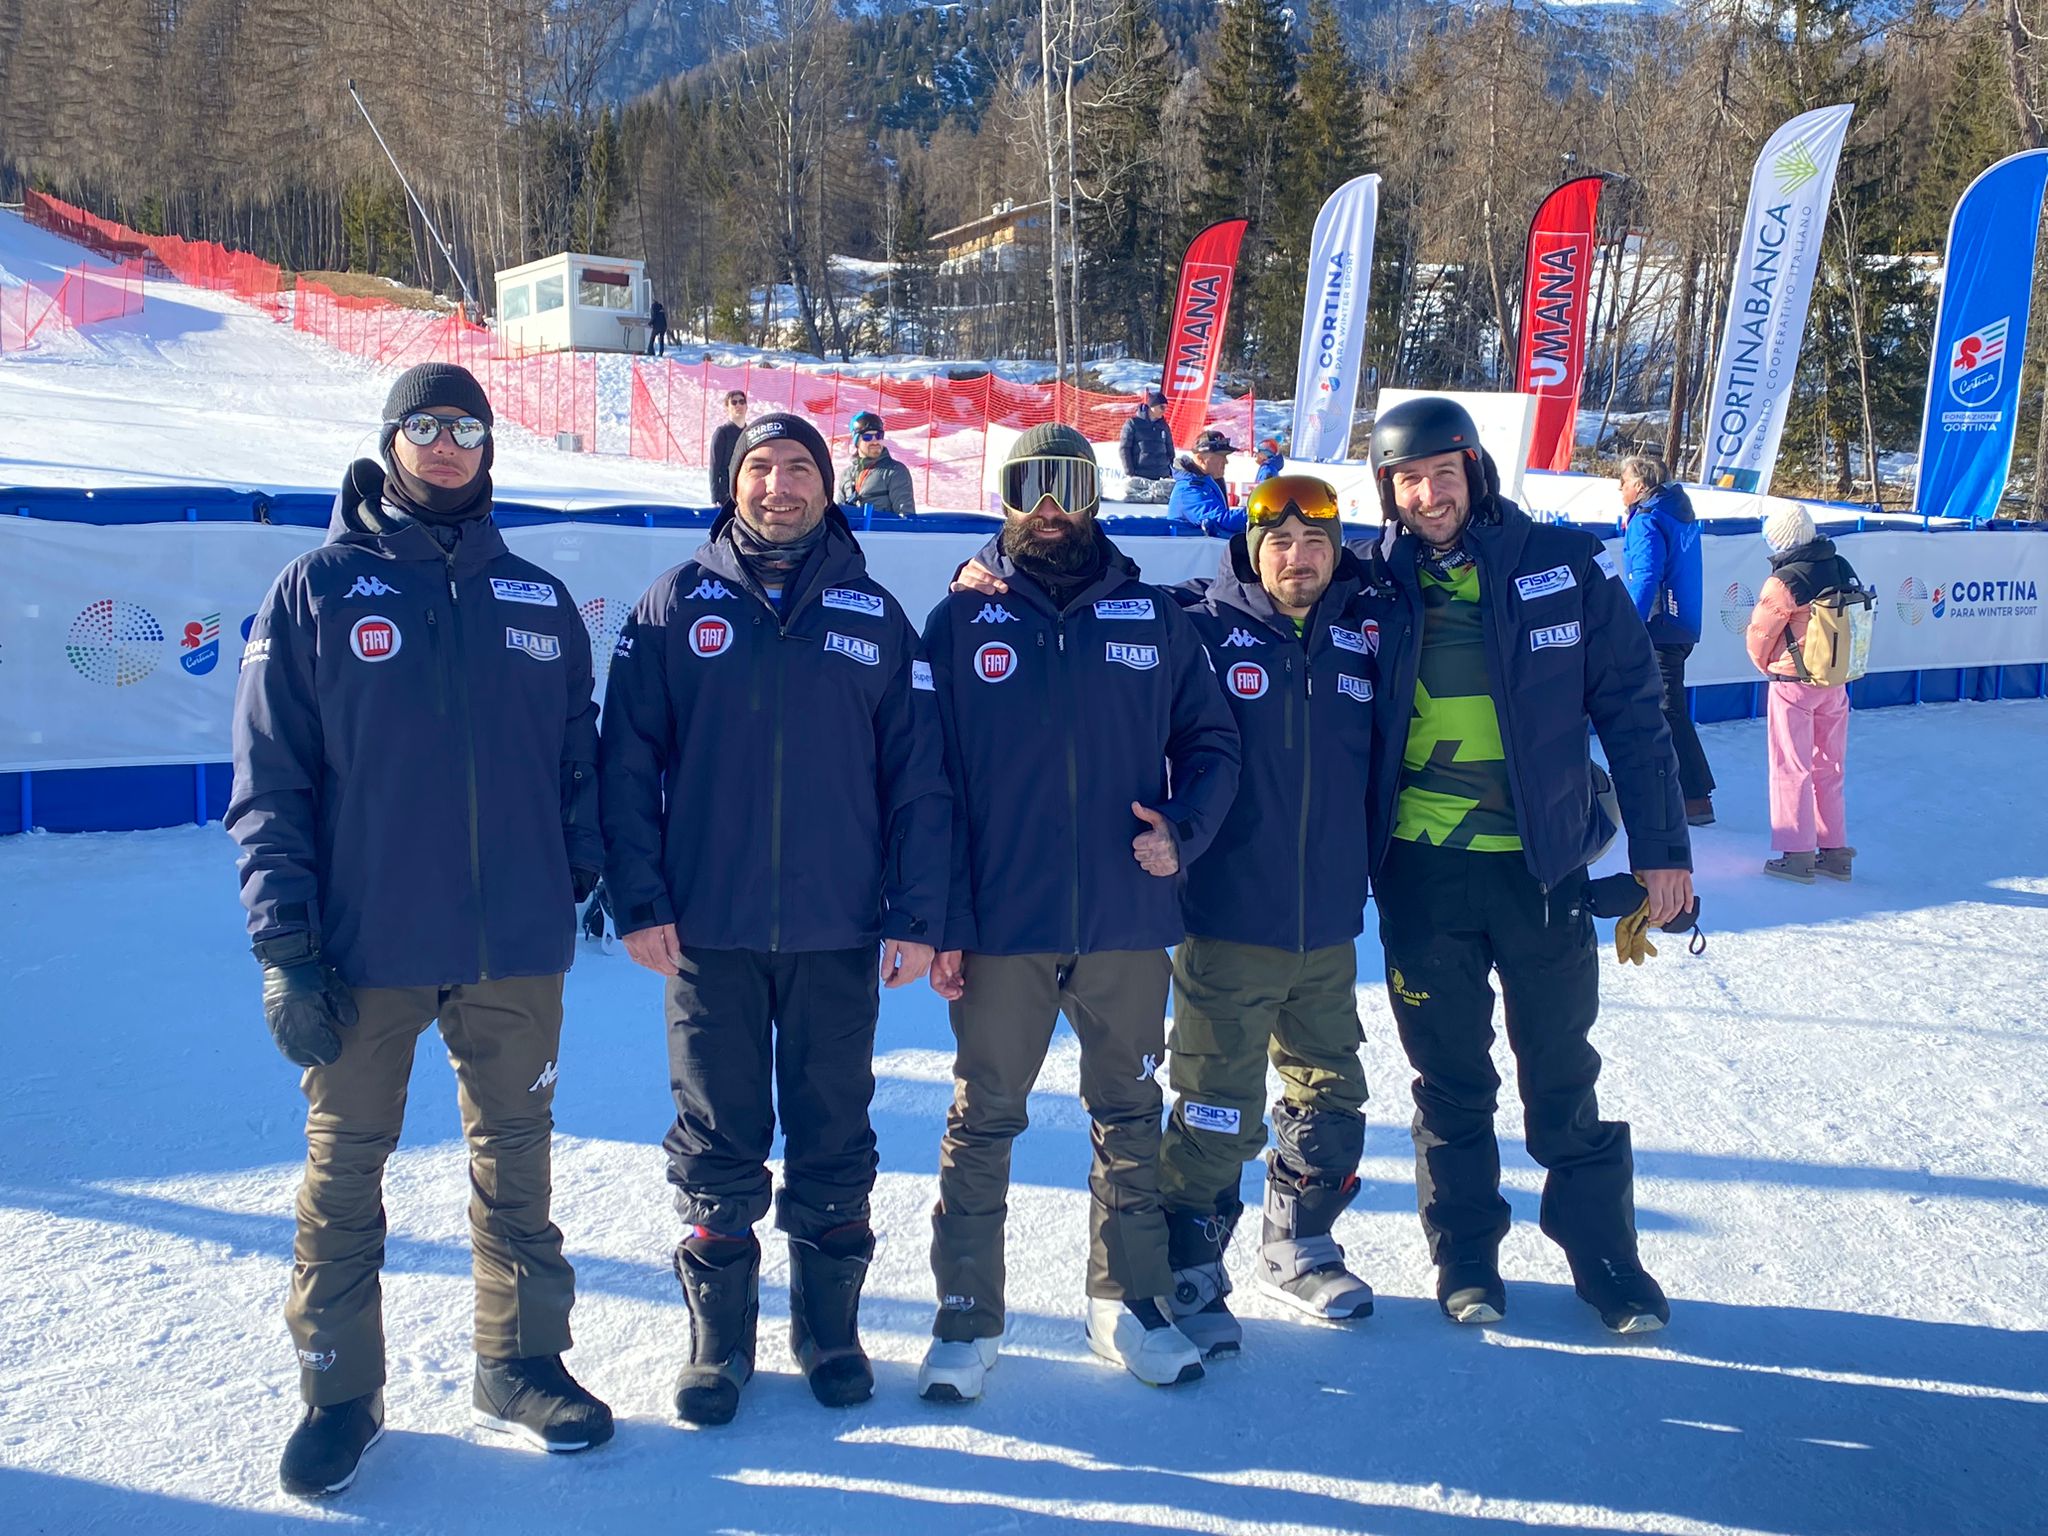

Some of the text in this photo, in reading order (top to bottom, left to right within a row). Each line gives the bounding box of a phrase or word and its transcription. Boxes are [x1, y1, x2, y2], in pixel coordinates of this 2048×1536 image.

[1319, 250, 1345, 369] CORTINA
[1335, 251, 1355, 370] PARA WINTER SPORT
[1529, 245, 1578, 388] UMANA
[1173, 274, 1222, 392] UMANA
[1716, 203, 1792, 457] CORTINABANCA
[1752, 206, 1812, 461] CREDITO COOPERATIVO ITALIANO
[1959, 371, 1995, 395] Cortina
[1943, 412, 1999, 421] FONDAZIONE
[1943, 422, 1998, 432] CORTINA
[493, 579, 540, 593] FISIP
[1518, 570, 1558, 589] FISIP
[824, 589, 870, 602] FISIP
[1951, 580, 2038, 603] CORTINA
[1095, 600, 1139, 611] FISIP
[1950, 607, 1976, 619] PARA
[1977, 606, 2013, 617] WINTER
[2014, 605, 2038, 616] SPORT
[361, 629, 391, 652] FIAT
[699, 627, 724, 648] FIAT
[185, 649, 216, 669] Cortina
[984, 653, 1009, 673] FIAT
[1236, 672, 1260, 691] FIAT
[1186, 1103, 1227, 1119] FISIP
